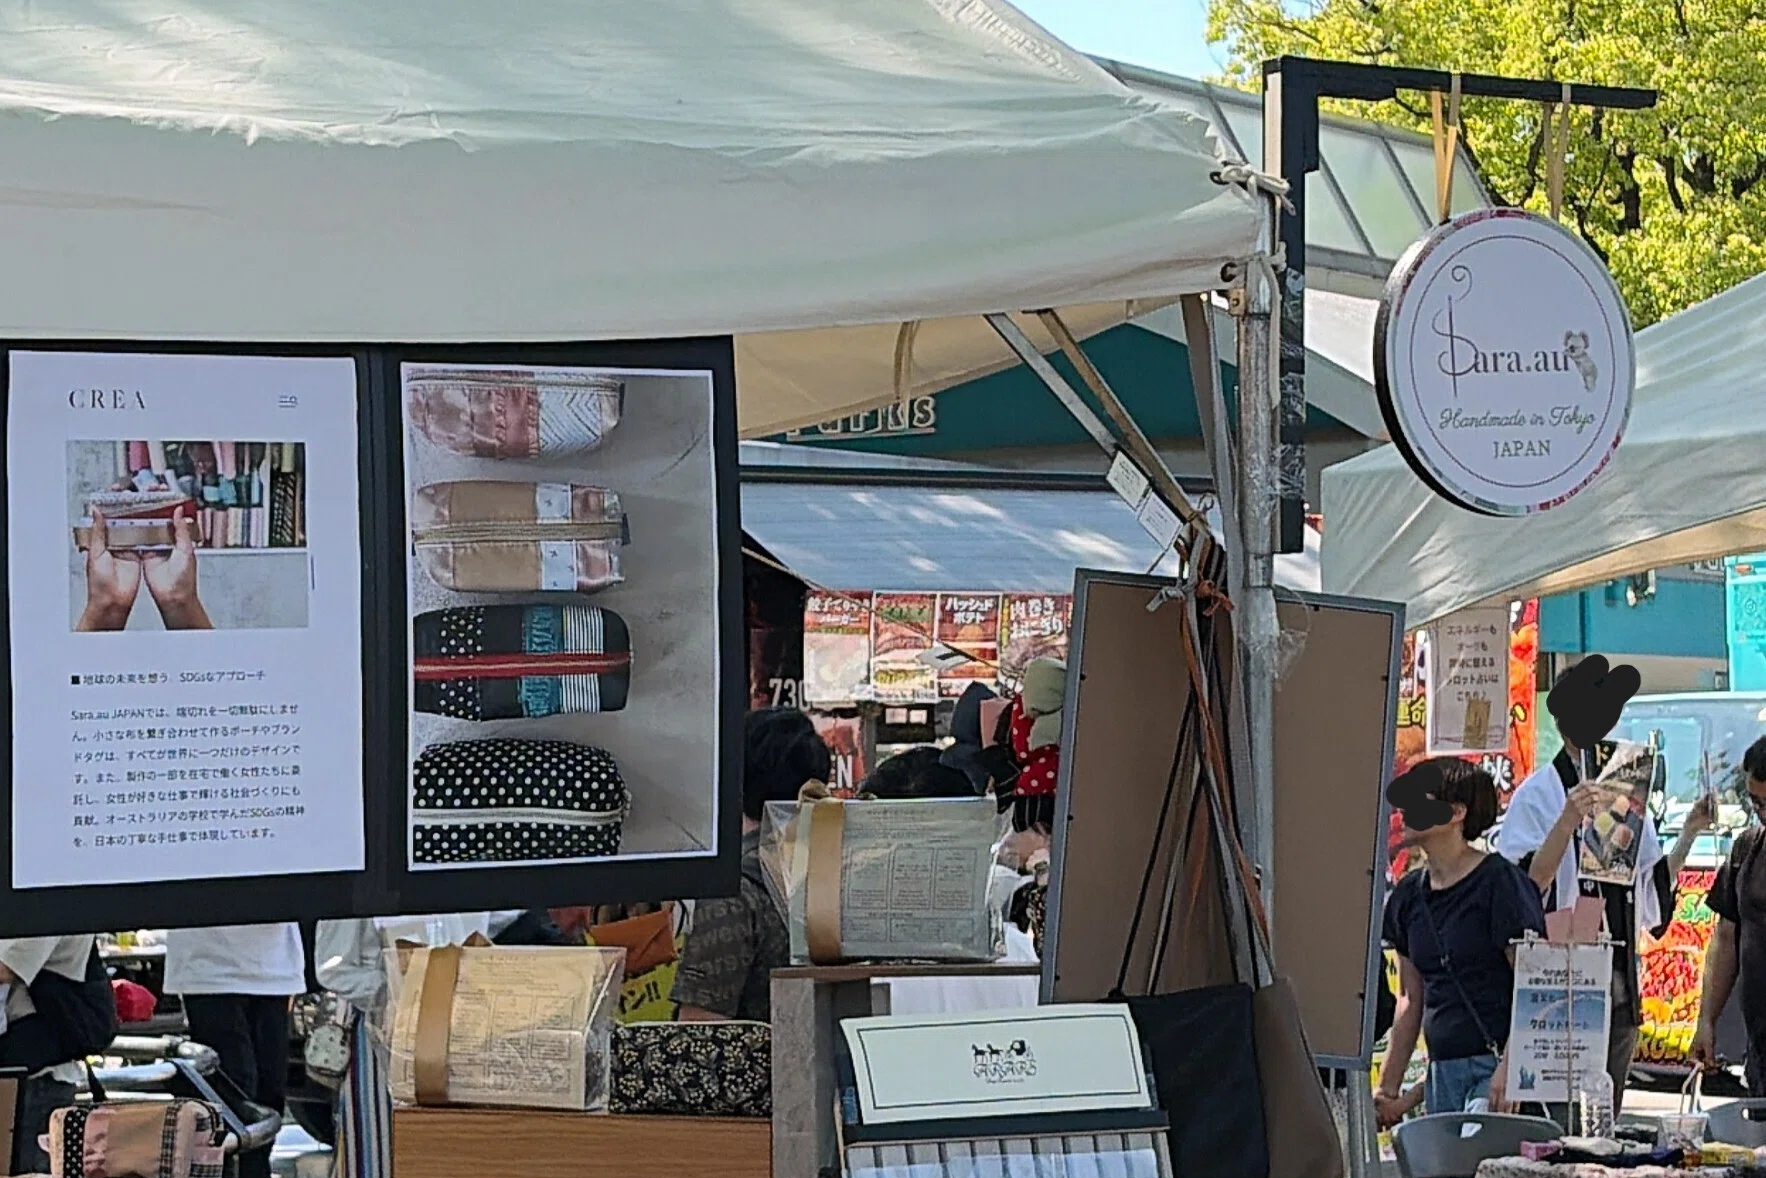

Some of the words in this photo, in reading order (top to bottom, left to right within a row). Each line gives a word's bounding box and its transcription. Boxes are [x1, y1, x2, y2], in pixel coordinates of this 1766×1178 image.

[1431, 294, 1571, 397] Sara.au
[69, 389, 147, 410] CREA
[1439, 408, 1526, 431] Handmade
[1530, 413, 1545, 427] in
[1549, 405, 1596, 434] Tokyo
[1493, 440, 1552, 458] JAPAN
